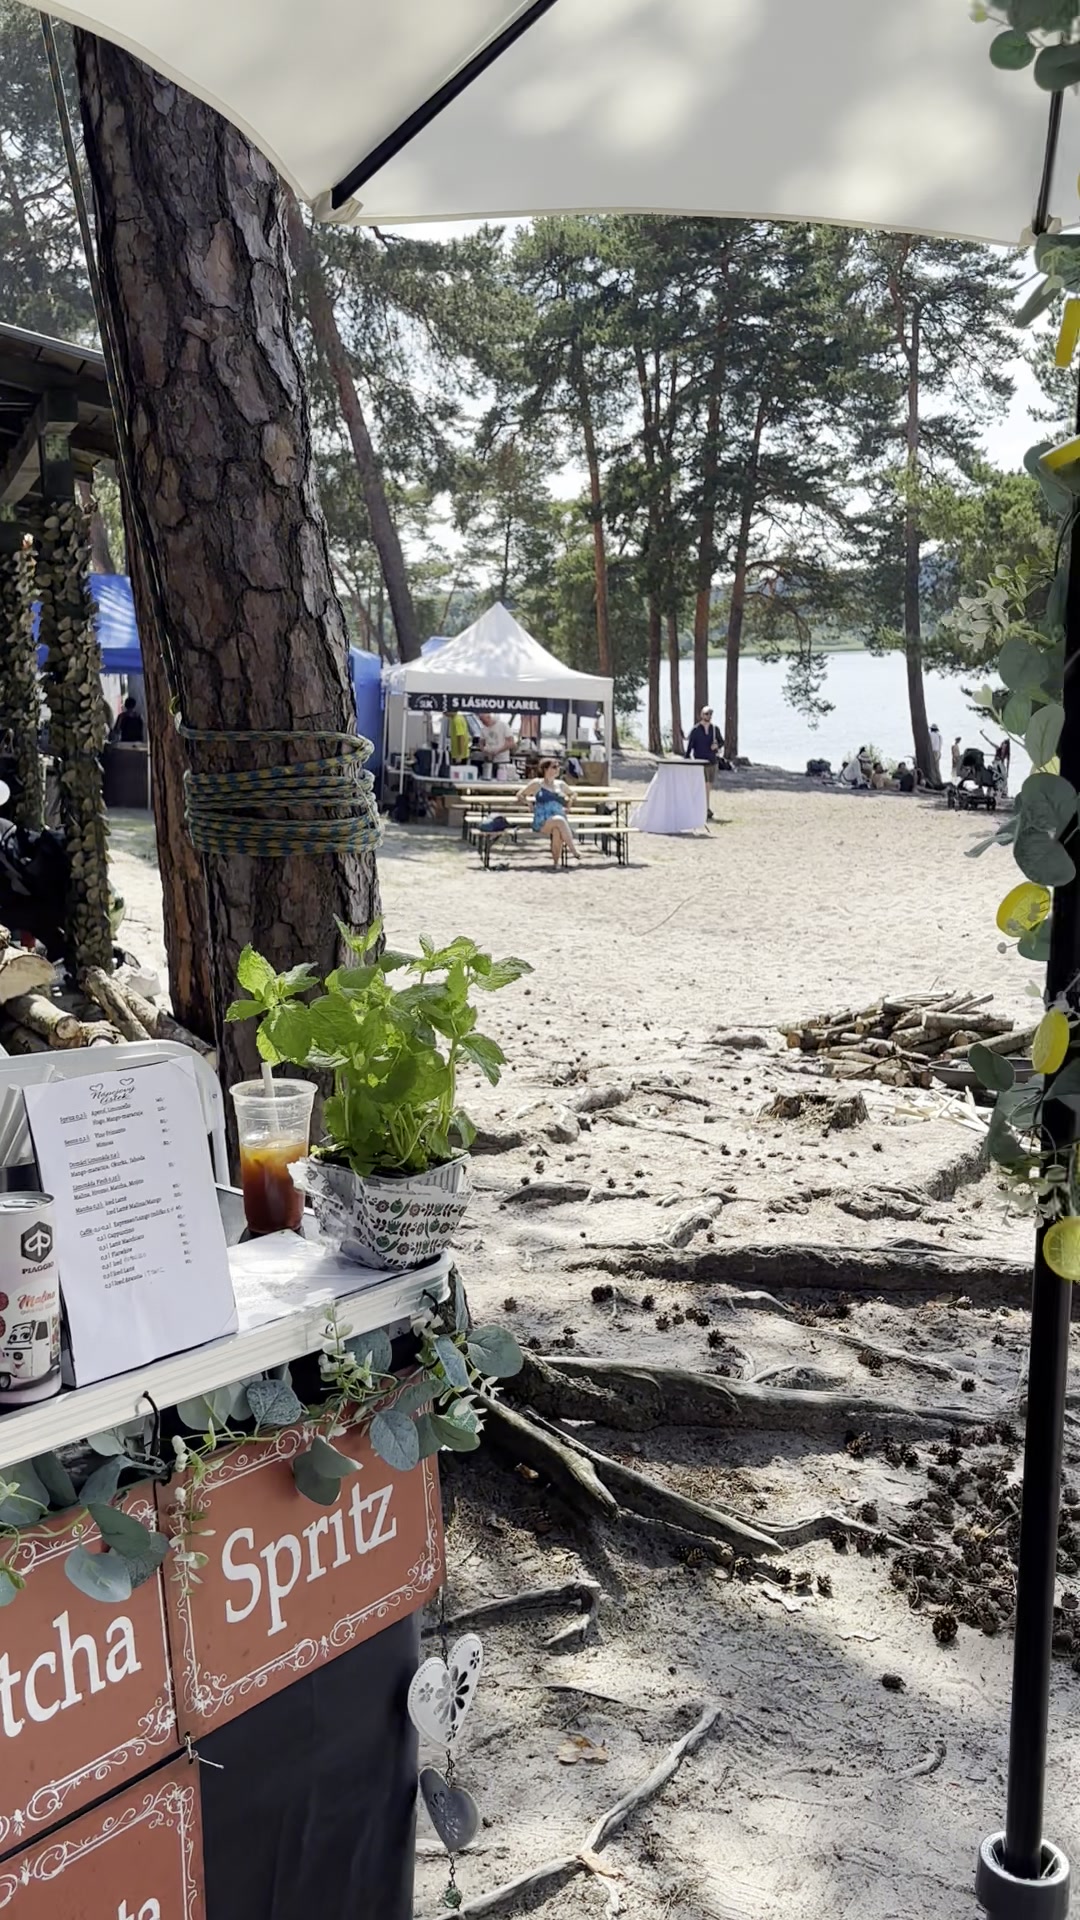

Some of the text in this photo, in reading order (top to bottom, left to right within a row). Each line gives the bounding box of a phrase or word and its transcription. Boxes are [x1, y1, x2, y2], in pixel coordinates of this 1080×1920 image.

[452, 696, 540, 710] S LÁSKOU KAREL
[222, 1482, 397, 1636] Spritz
